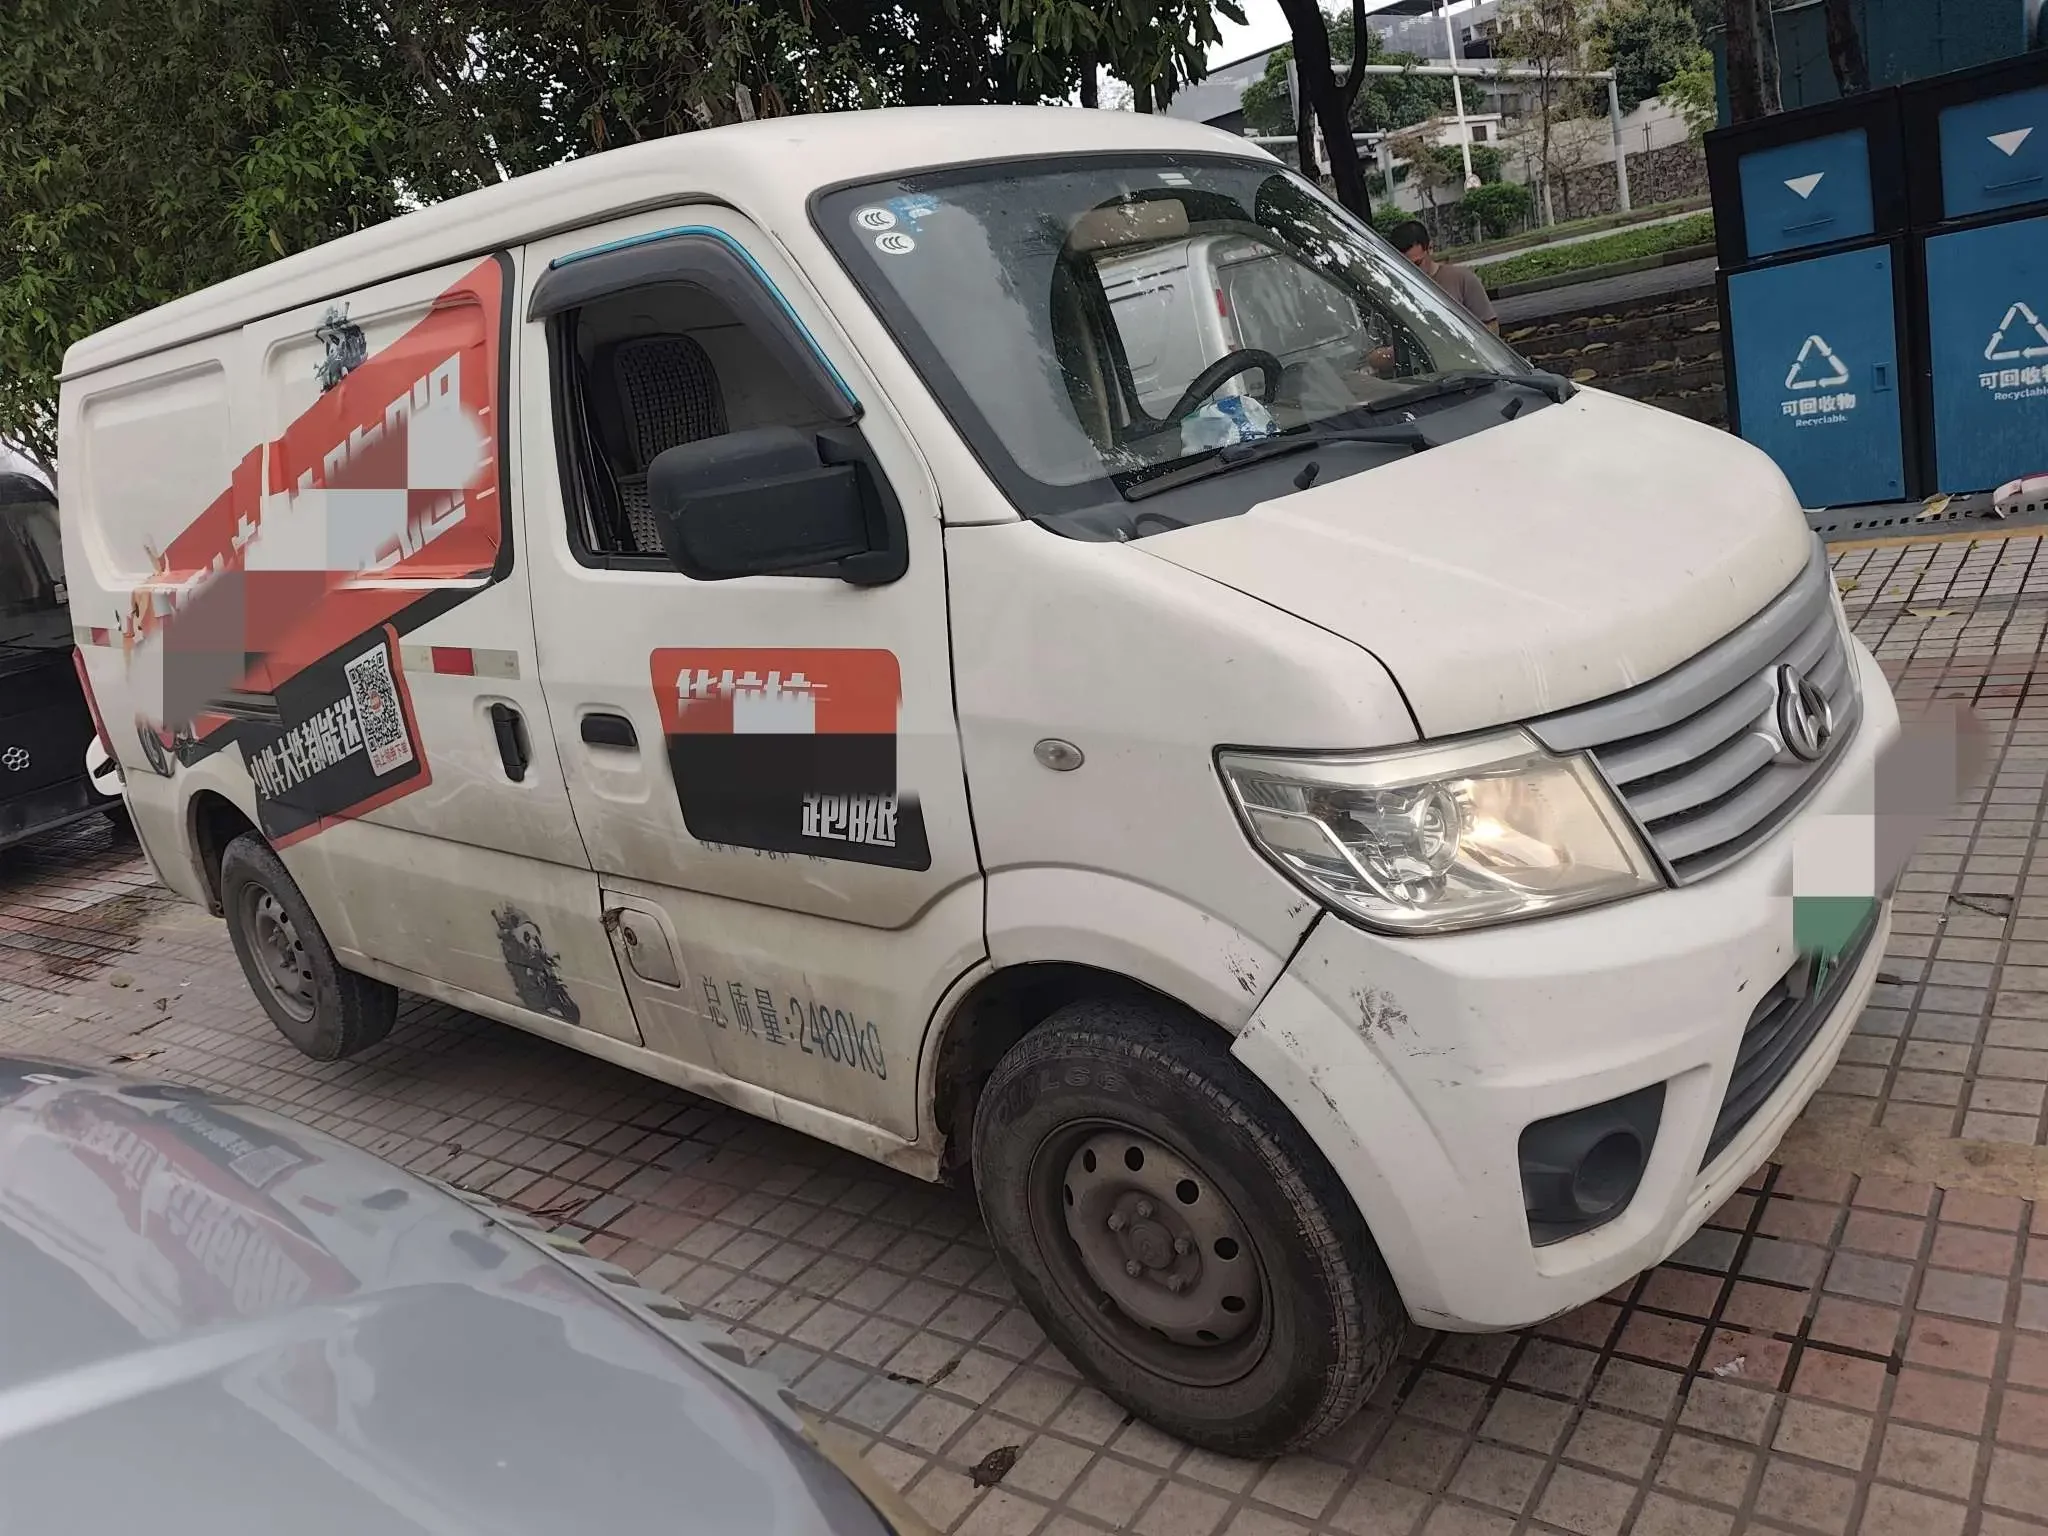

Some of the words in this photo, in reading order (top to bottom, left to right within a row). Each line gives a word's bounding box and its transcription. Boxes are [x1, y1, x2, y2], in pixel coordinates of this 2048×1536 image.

[1994, 386, 2048, 401] Recyclabl
[1780, 393, 1856, 416] 可回收物
[1795, 414, 1848, 427] Recyclable
[250, 695, 363, 800] 小件大件都能送
